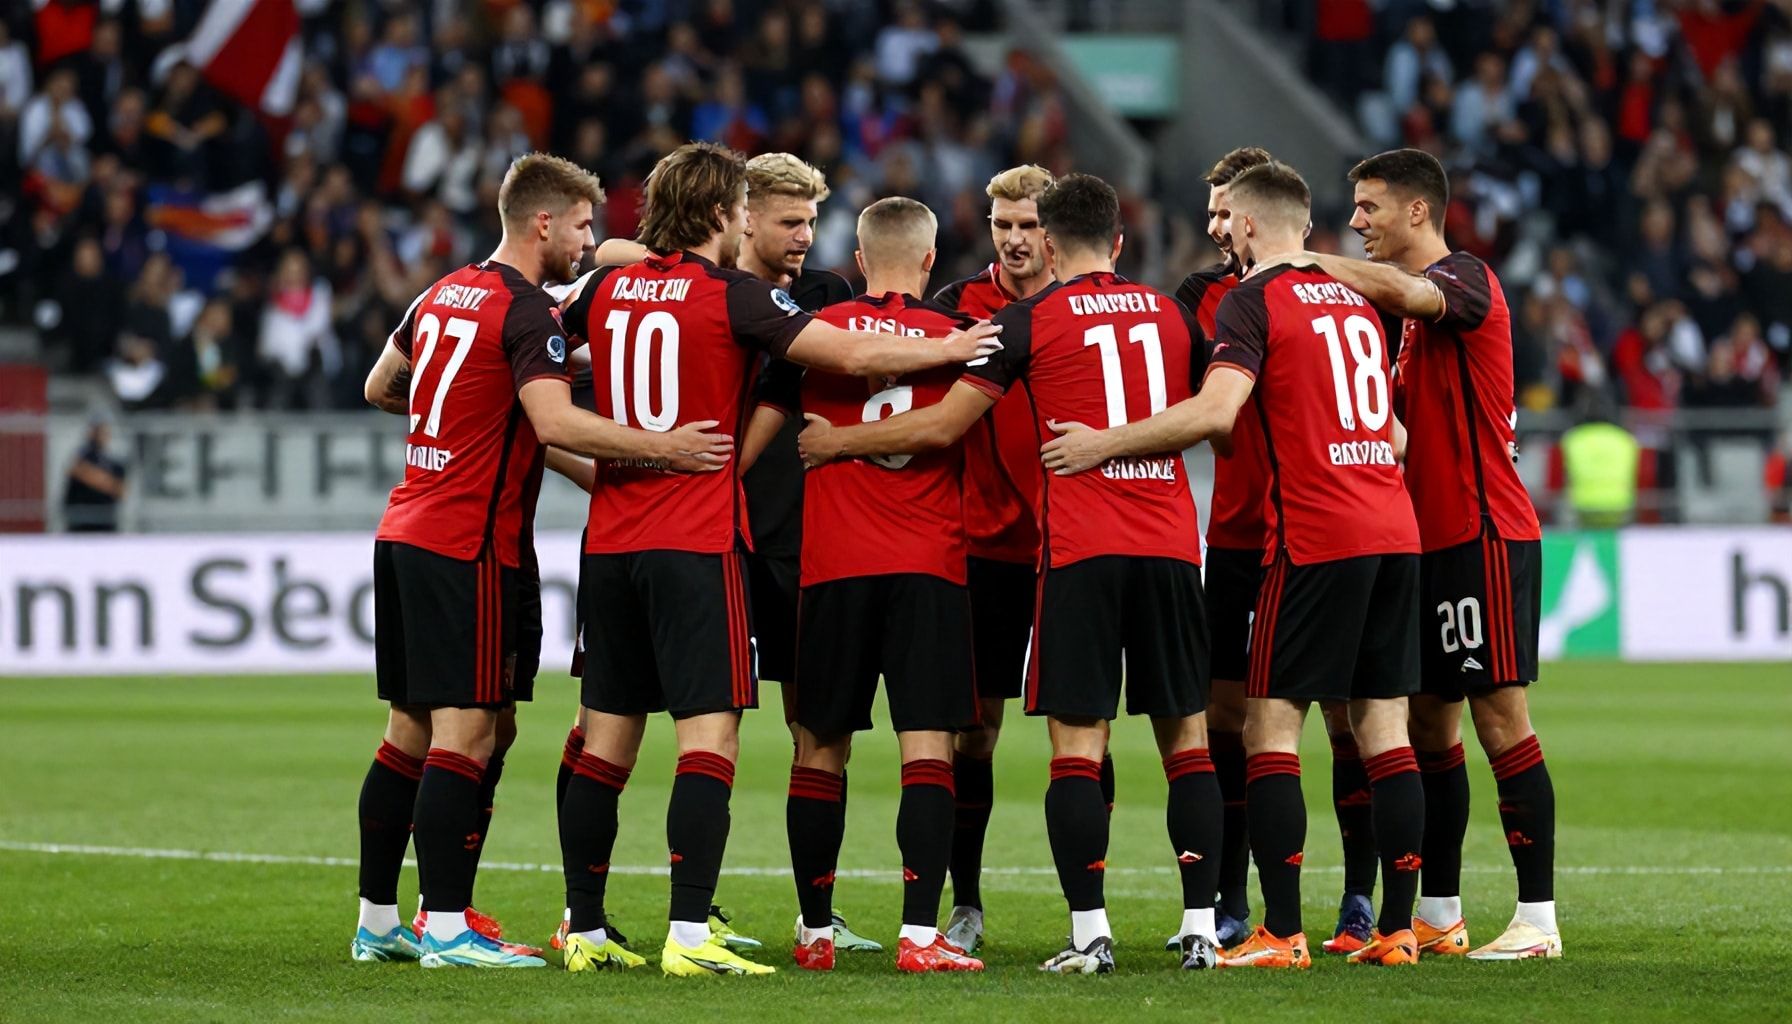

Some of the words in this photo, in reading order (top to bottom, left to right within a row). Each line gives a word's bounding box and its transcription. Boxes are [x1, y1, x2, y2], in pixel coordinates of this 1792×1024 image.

[409, 312, 479, 438] 27
[605, 309, 679, 433] 10
[1083, 322, 1168, 429] 11
[1311, 314, 1389, 432] 18
[1, 577, 154, 648] nn
[1436, 596, 1484, 653] 20
